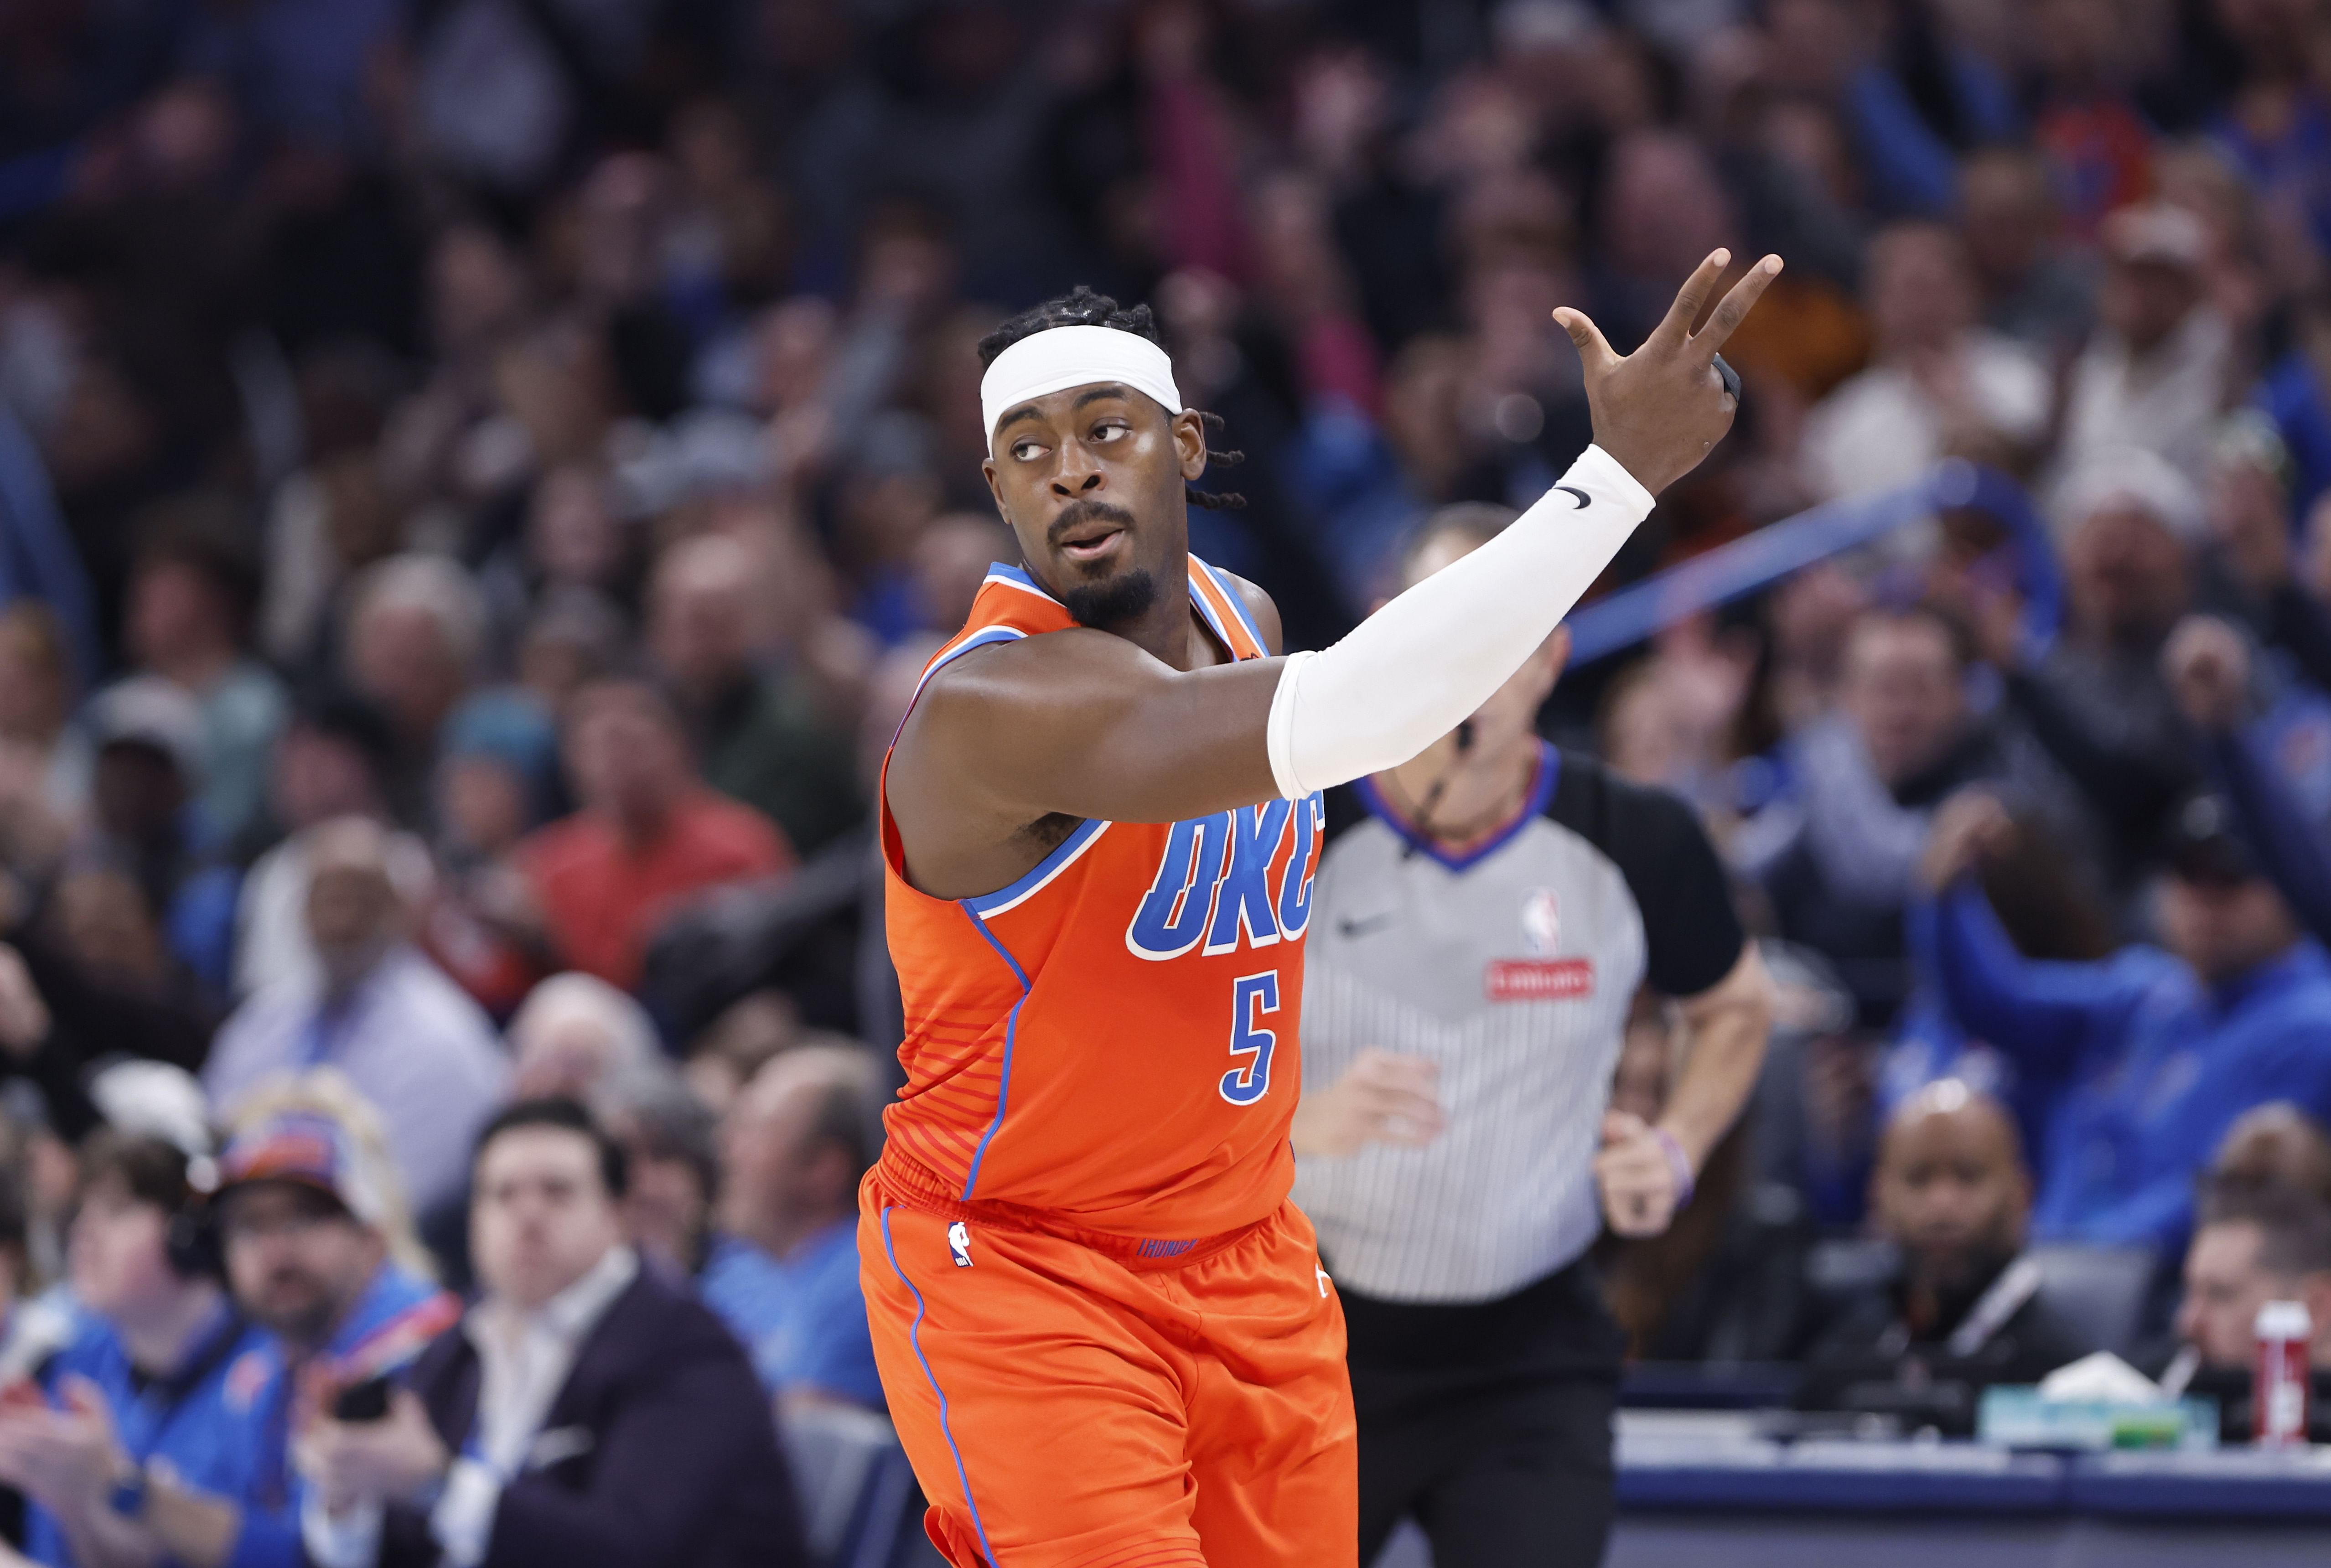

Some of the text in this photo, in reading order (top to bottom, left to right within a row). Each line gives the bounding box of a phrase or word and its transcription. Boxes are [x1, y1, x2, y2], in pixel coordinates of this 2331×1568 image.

[1124, 790, 1325, 961] OKC
[1219, 969, 1280, 1106] 5
[955, 1257, 968, 1266] NBA
